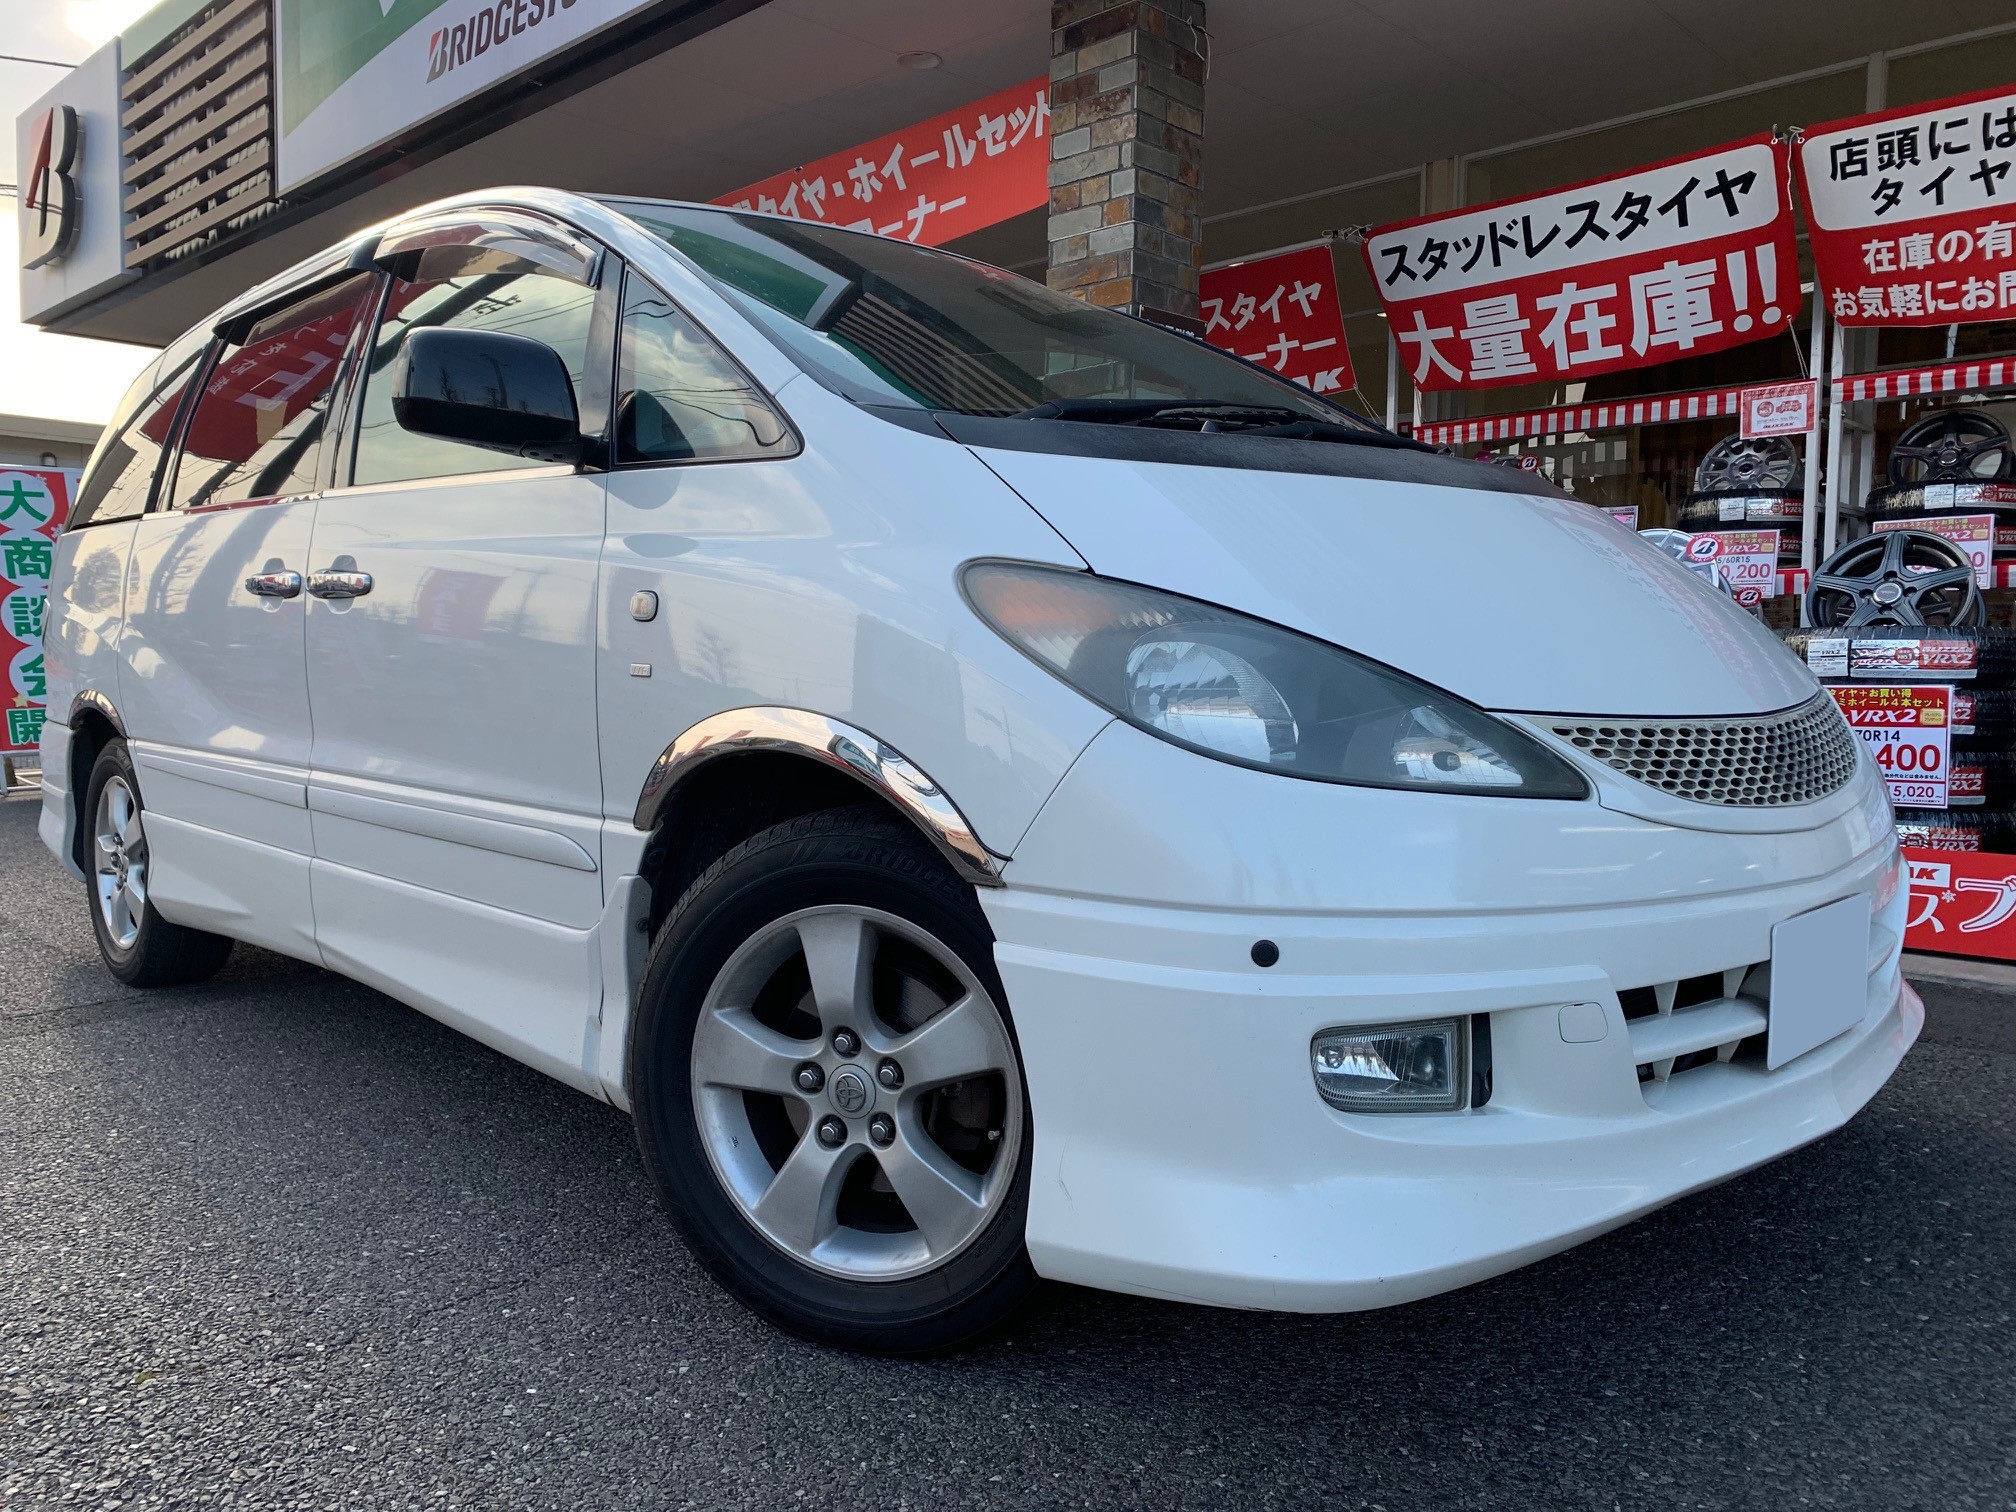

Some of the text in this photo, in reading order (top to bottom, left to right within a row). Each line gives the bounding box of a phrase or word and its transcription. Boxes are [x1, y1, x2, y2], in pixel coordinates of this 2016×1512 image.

[1830, 107, 2016, 181] 店頭には
[1871, 158, 2012, 216] タイヤ
[1380, 168, 1758, 287] スタッドレスタイヤ
[1862, 220, 2016, 274] 在庫の有
[1398, 242, 1783, 385] 大量在庫!!
[1225, 333, 1337, 372] ーナー
[1724, 543, 1759, 554] VRX2
[1922, 653, 1973, 665] VRX2
[1850, 709, 1917, 724] VRX2
[1932, 840, 1979, 851] VRX2
